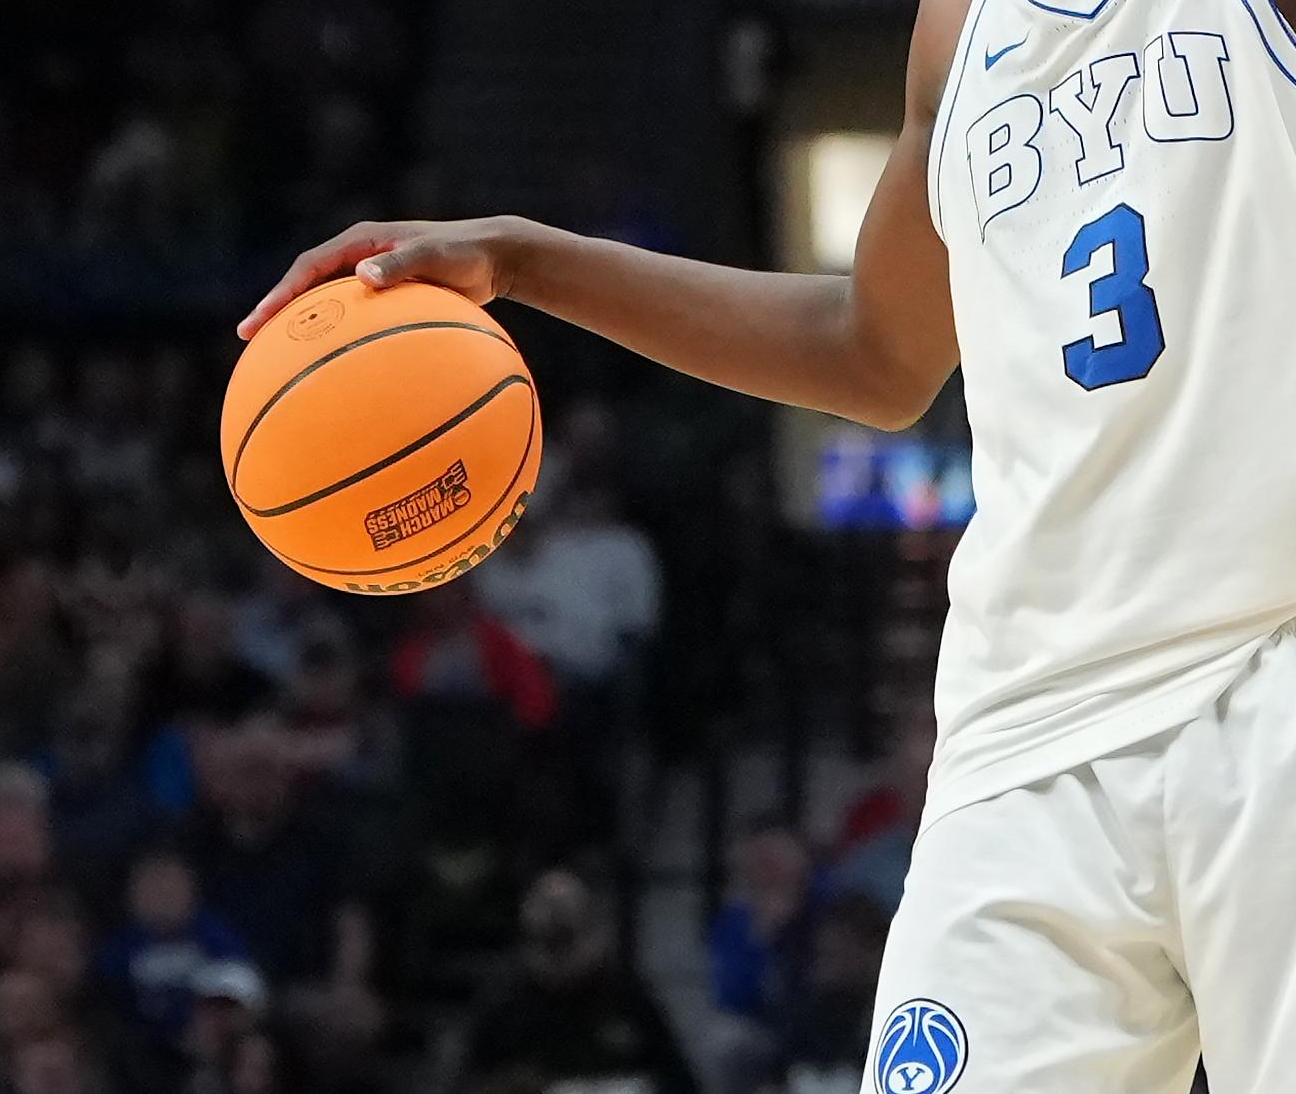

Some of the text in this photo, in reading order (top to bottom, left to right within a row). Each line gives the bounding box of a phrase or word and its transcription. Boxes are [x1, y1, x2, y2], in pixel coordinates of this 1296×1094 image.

[966, 31, 1232, 246] BYU
[1060, 202, 1166, 392] 3
[365, 487, 443, 535] MADNESS
[400, 489, 455, 538] MARCH
[896, 1066, 926, 1091] Y
